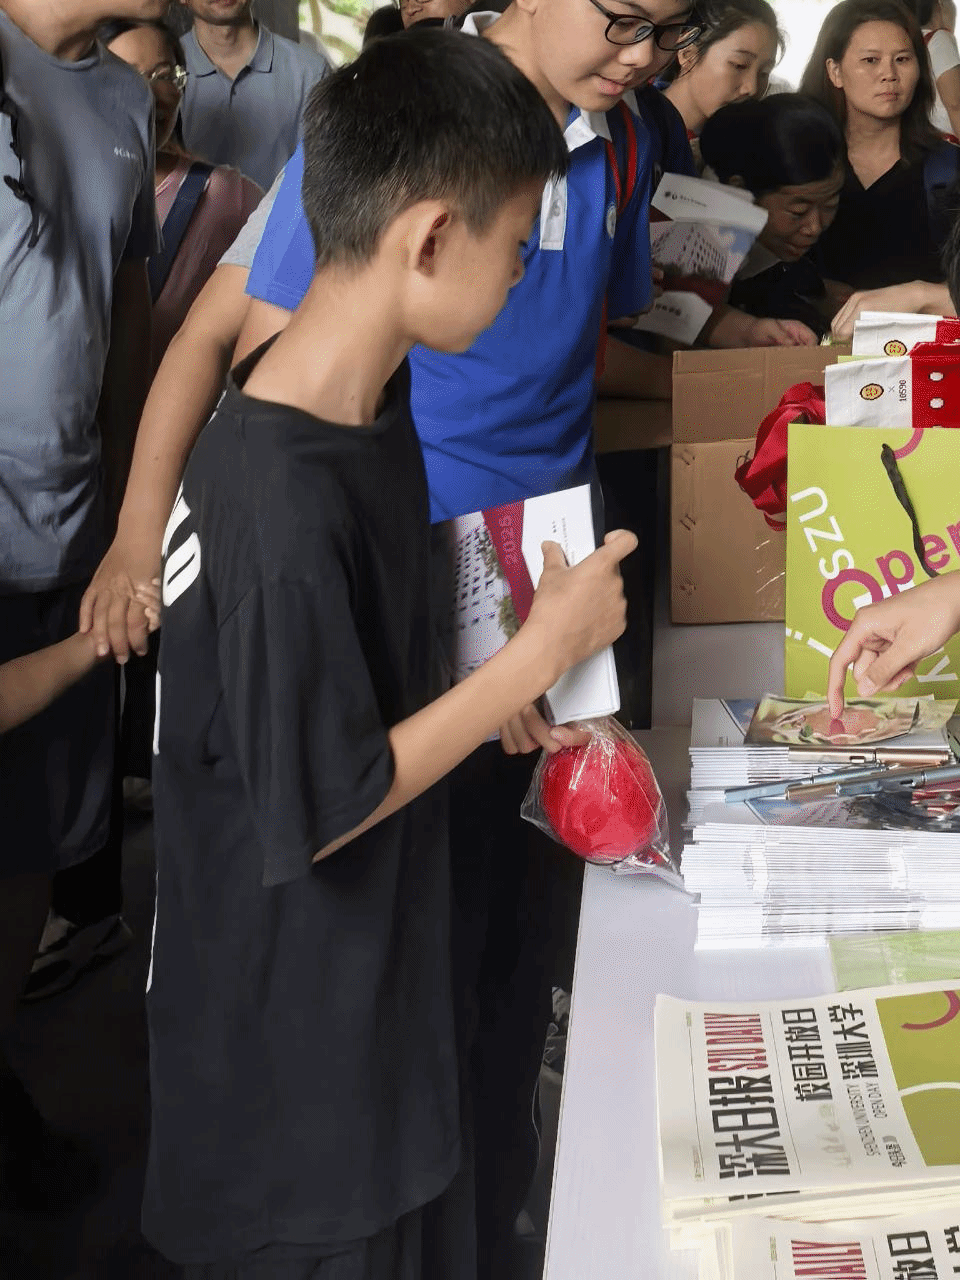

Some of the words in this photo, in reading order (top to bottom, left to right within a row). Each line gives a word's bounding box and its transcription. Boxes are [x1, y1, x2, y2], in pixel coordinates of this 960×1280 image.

[899, 379, 907, 402] 10590
[703, 1012, 765, 1045] DAILY
[828, 1003, 879, 1080] 深圳大学
[707, 1048, 769, 1072] SZU
[781, 1008, 833, 1102] 校园开放日
[847, 1083, 870, 1126] UNIVERSITY
[865, 1082, 882, 1098] DAY
[708, 1074, 790, 1179] 深大日报
[871, 1100, 888, 1119] OPEN
[791, 1240, 867, 1280] AILY
